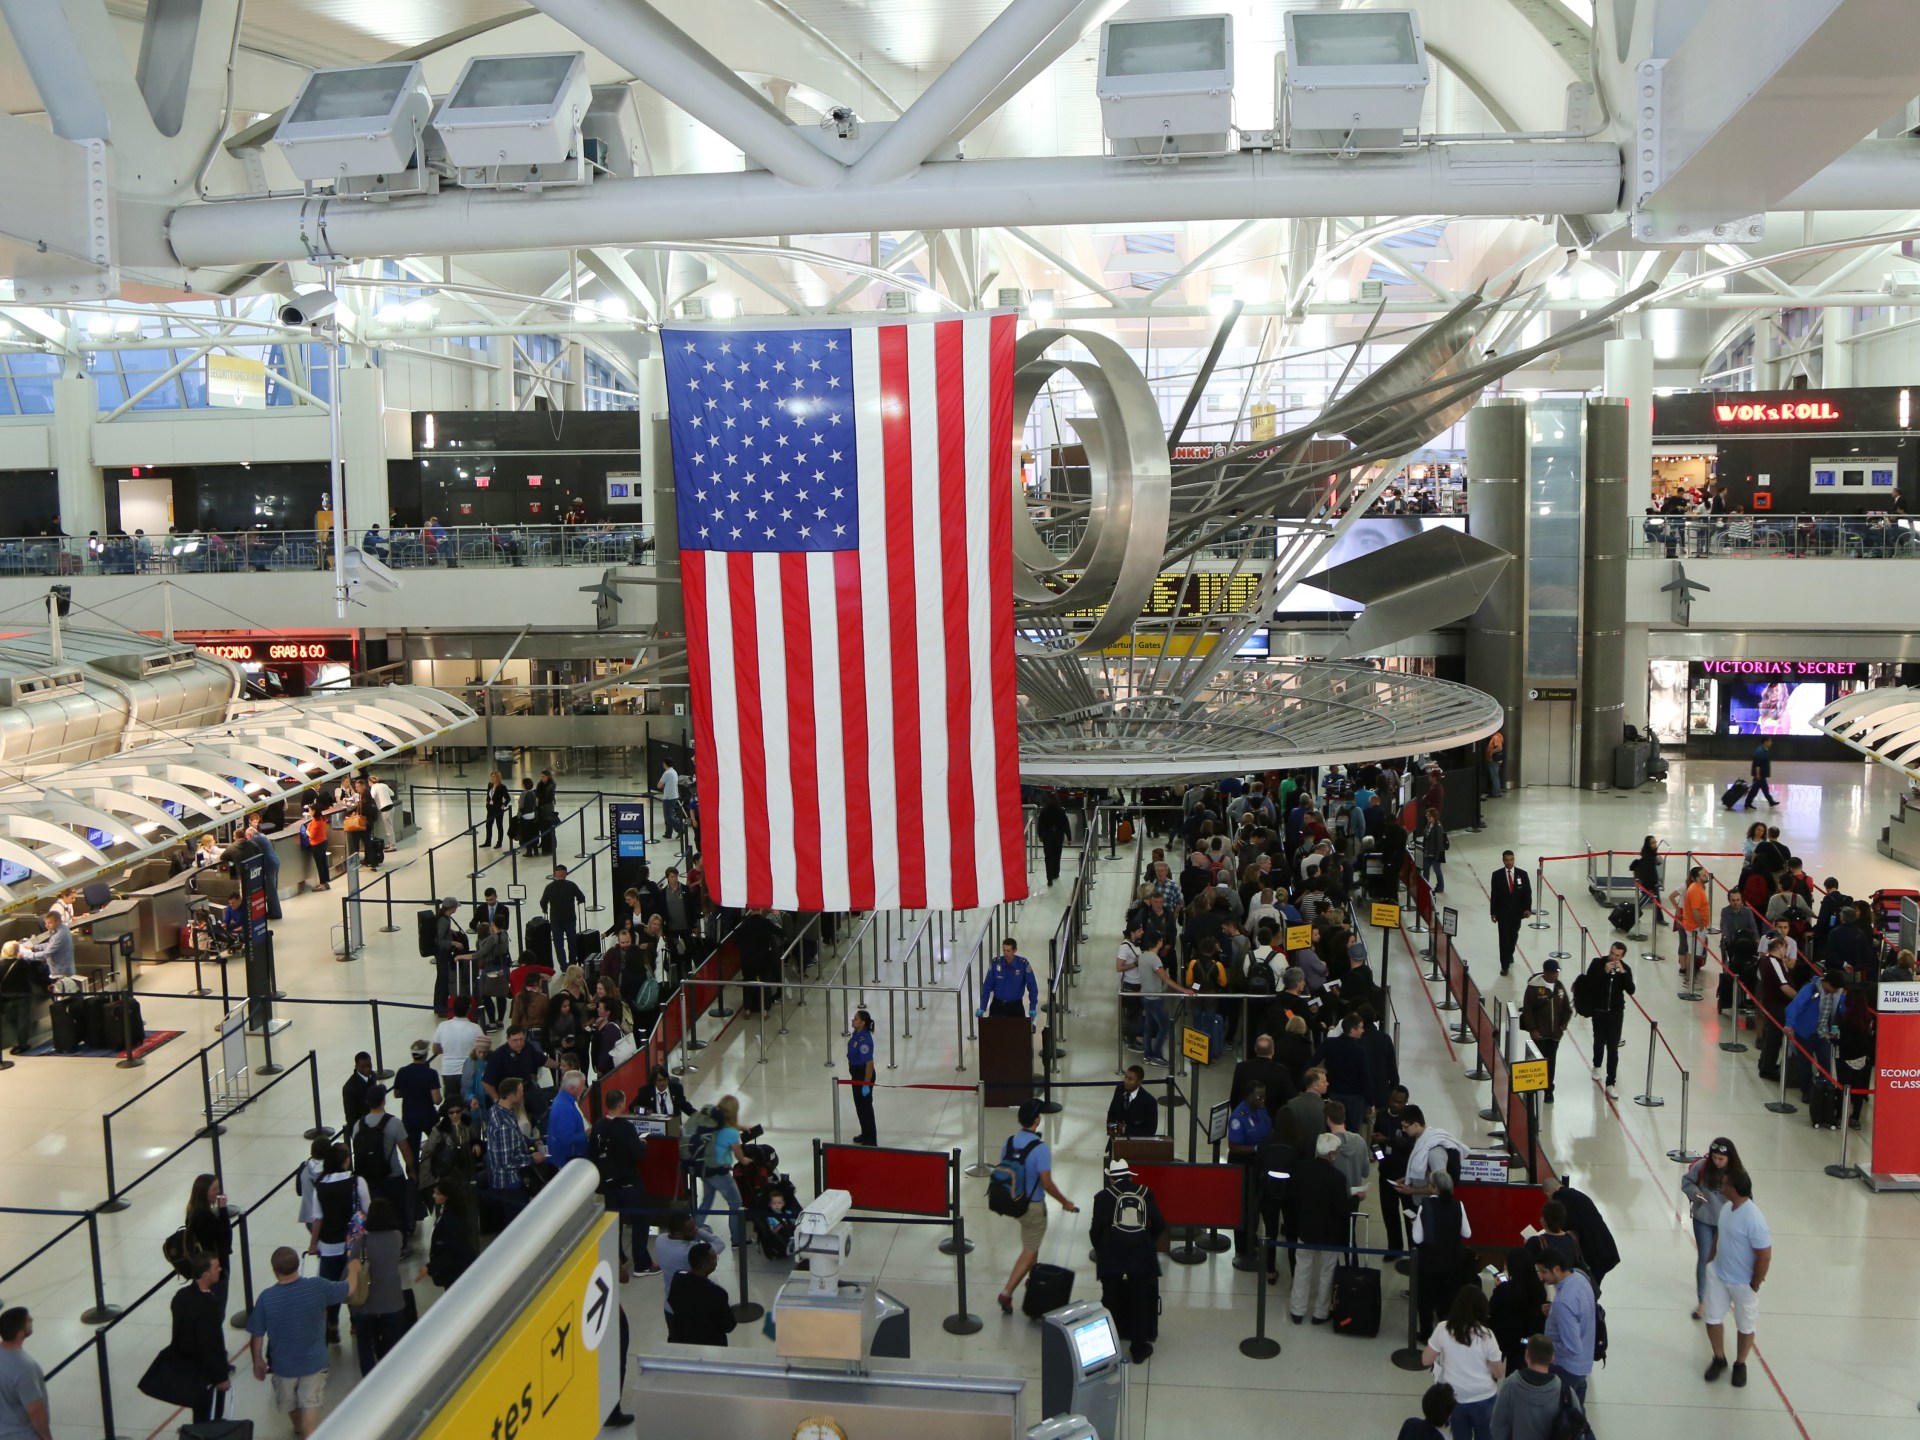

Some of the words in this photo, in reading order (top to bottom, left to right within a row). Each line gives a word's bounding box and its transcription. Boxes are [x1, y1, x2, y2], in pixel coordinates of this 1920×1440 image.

[210, 368, 233, 379] SECURITY
[269, 645, 298, 659] GRAB
[299, 645, 308, 659] &
[308, 644, 326, 658] GO
[1139, 642, 1161, 650] Gates
[1703, 661, 1792, 674] VICTORIA'S
[1797, 662, 1857, 674] SECRET
[620, 813, 640, 821] LOT
[610, 813, 618, 848] ALLIANCE
[250, 866, 263, 880] LOT
[1890, 1081, 1920, 1089] CLASS
